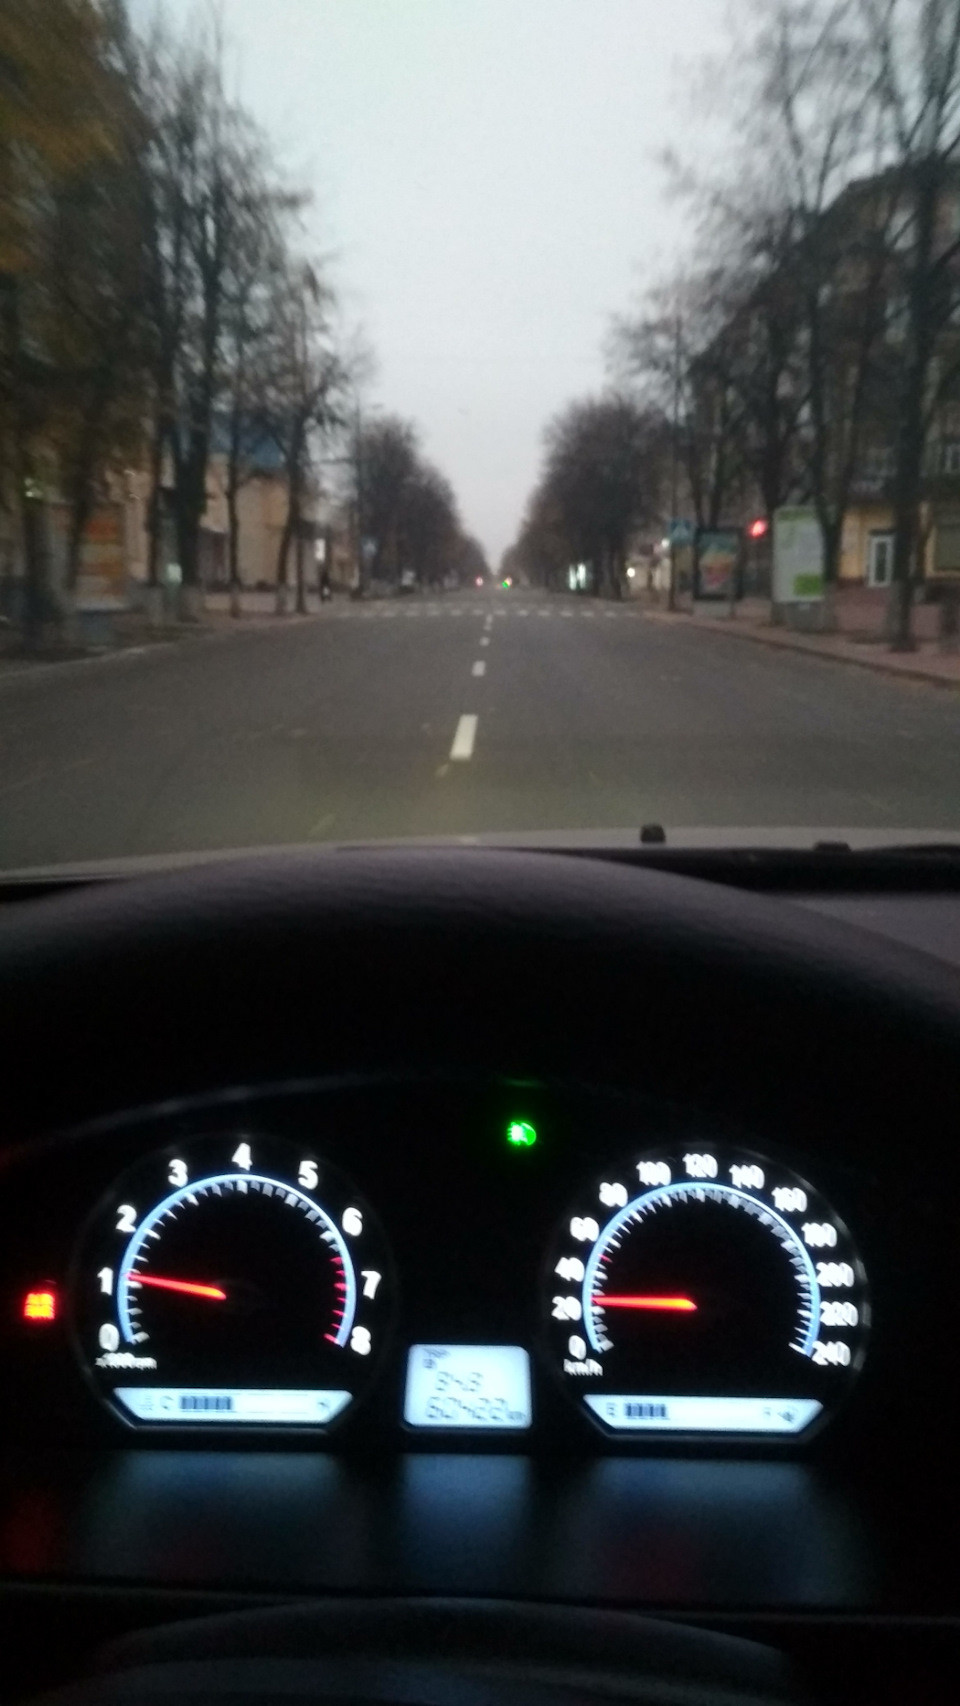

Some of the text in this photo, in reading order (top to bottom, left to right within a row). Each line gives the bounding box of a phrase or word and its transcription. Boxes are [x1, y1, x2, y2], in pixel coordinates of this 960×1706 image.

[231, 1142, 253, 1171] 4
[683, 1152, 718, 1178] 120
[167, 1159, 189, 1187] 3
[297, 1160, 319, 1189] 5
[636, 1161, 671, 1186] 100
[729, 1165, 765, 1189] 140
[599, 1182, 629, 1207] 80
[771, 1187, 807, 1212] 160
[116, 1204, 138, 1232] 2
[342, 1207, 363, 1237] 6
[569, 1216, 600, 1242] 60
[97, 1267, 113, 1296] 1
[554, 1257, 585, 1282] 40
[361, 1270, 382, 1300] 7
[551, 1296, 582, 1321] 20
[98, 1323, 119, 1351] 0
[350, 1325, 372, 1356] 8
[568, 1335, 587, 1360] 0
[812, 1341, 851, 1366] 240
